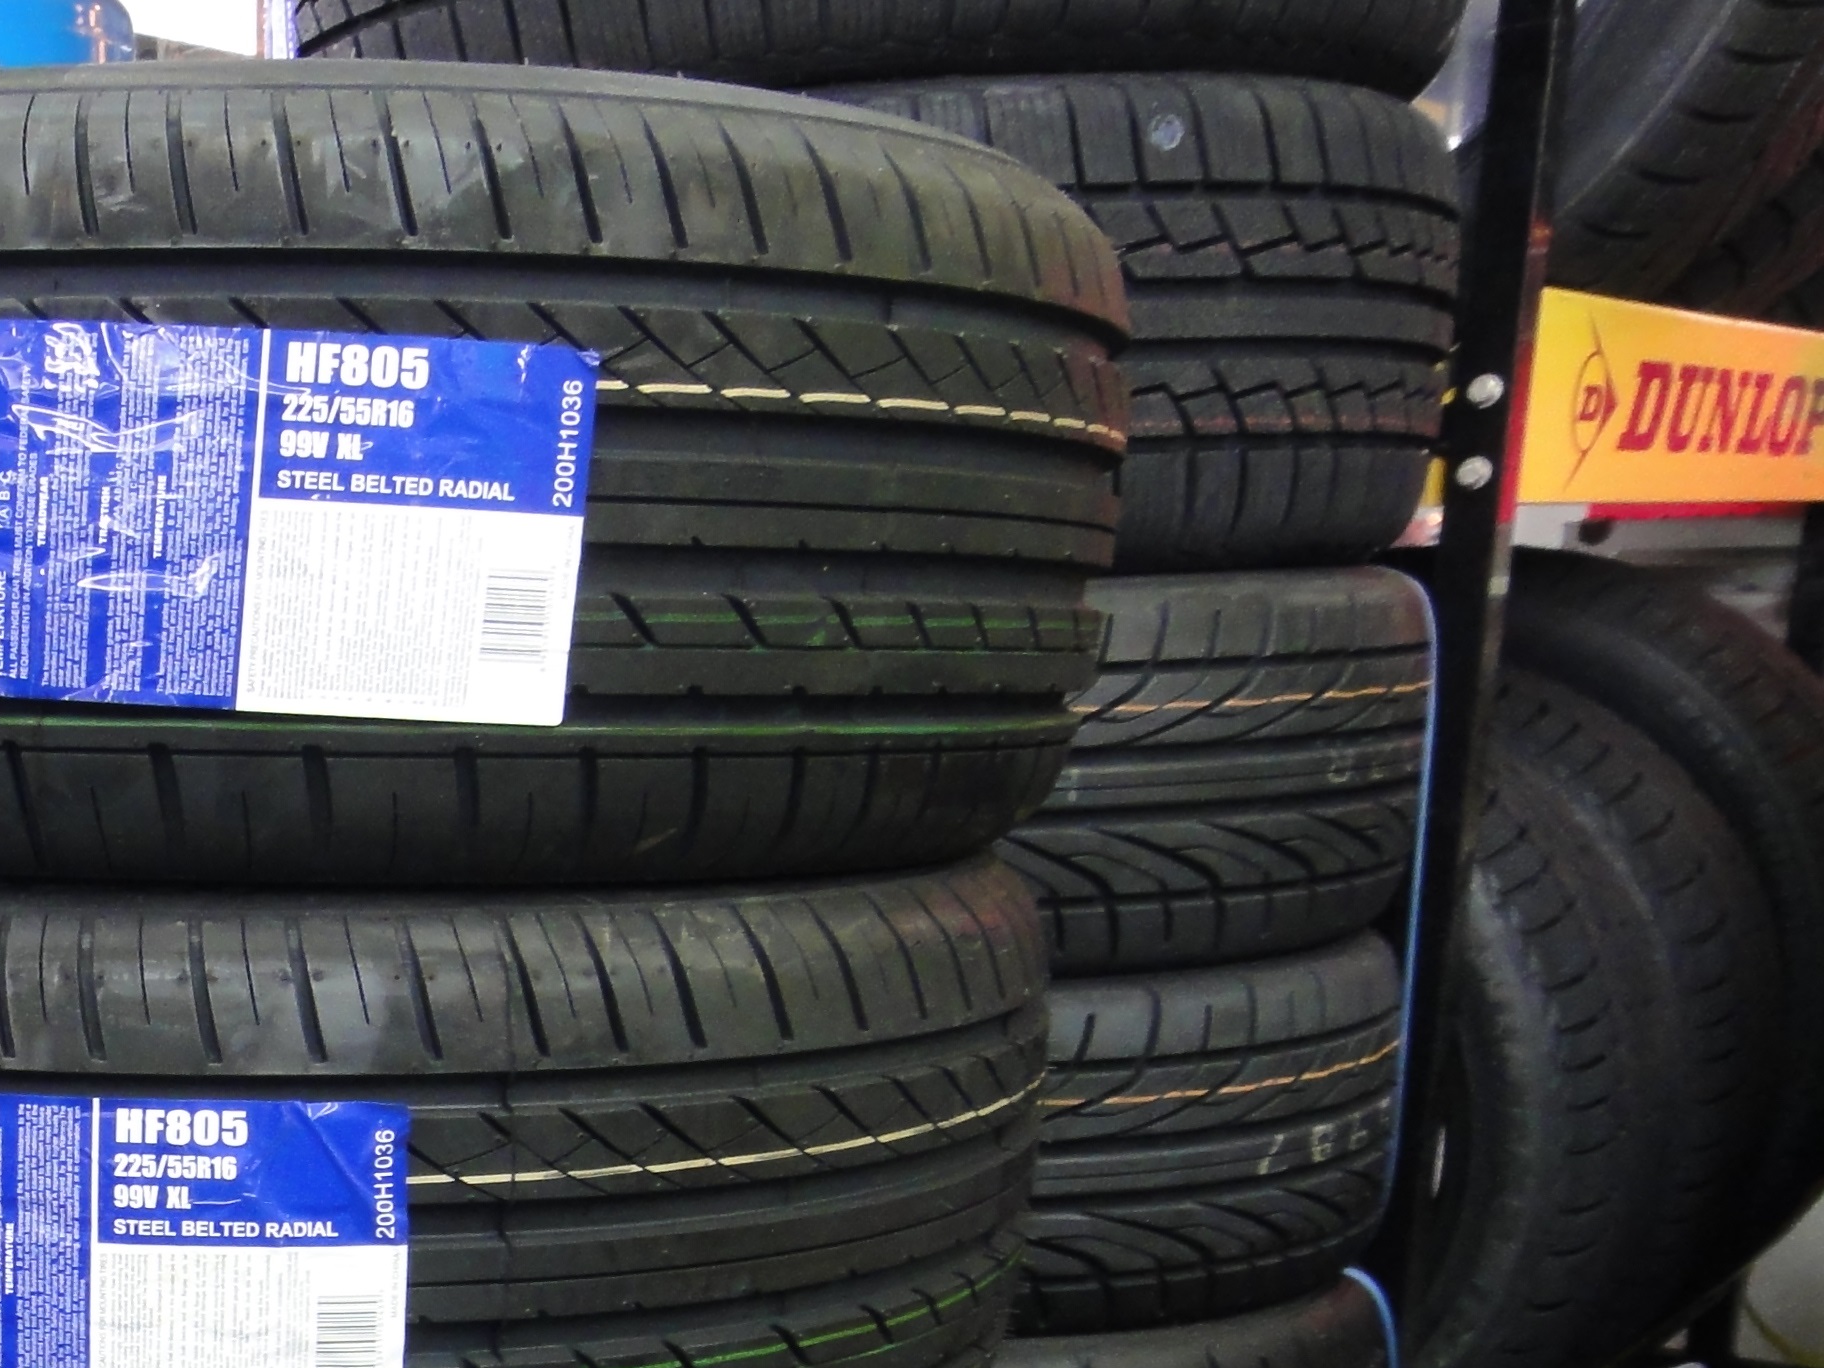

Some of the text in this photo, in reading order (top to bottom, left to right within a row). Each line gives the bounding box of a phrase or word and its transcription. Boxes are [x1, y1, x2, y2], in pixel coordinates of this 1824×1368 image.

[285, 341, 430, 390] HF805
[281, 393, 415, 429] 225/55R16
[279, 429, 364, 462] 99V XL
[552, 378, 585, 509] 200H1036
[276, 469, 516, 502] STEEL BELTED RADIAL
[37, 477, 49, 546] TREADWEAR
[153, 475, 167, 559] TEMPERATURE
[9, 661, 18, 679] ALL
[115, 1108, 249, 1147] HF805
[113, 1153, 238, 1181] 225/55R16
[373, 1128, 396, 1240] 200H1036
[113, 1184, 192, 1210] 99V XL
[113, 1219, 339, 1238] STEEL BELTED RADIAL
[4, 1223, 14, 1295] TEMPERATURE
